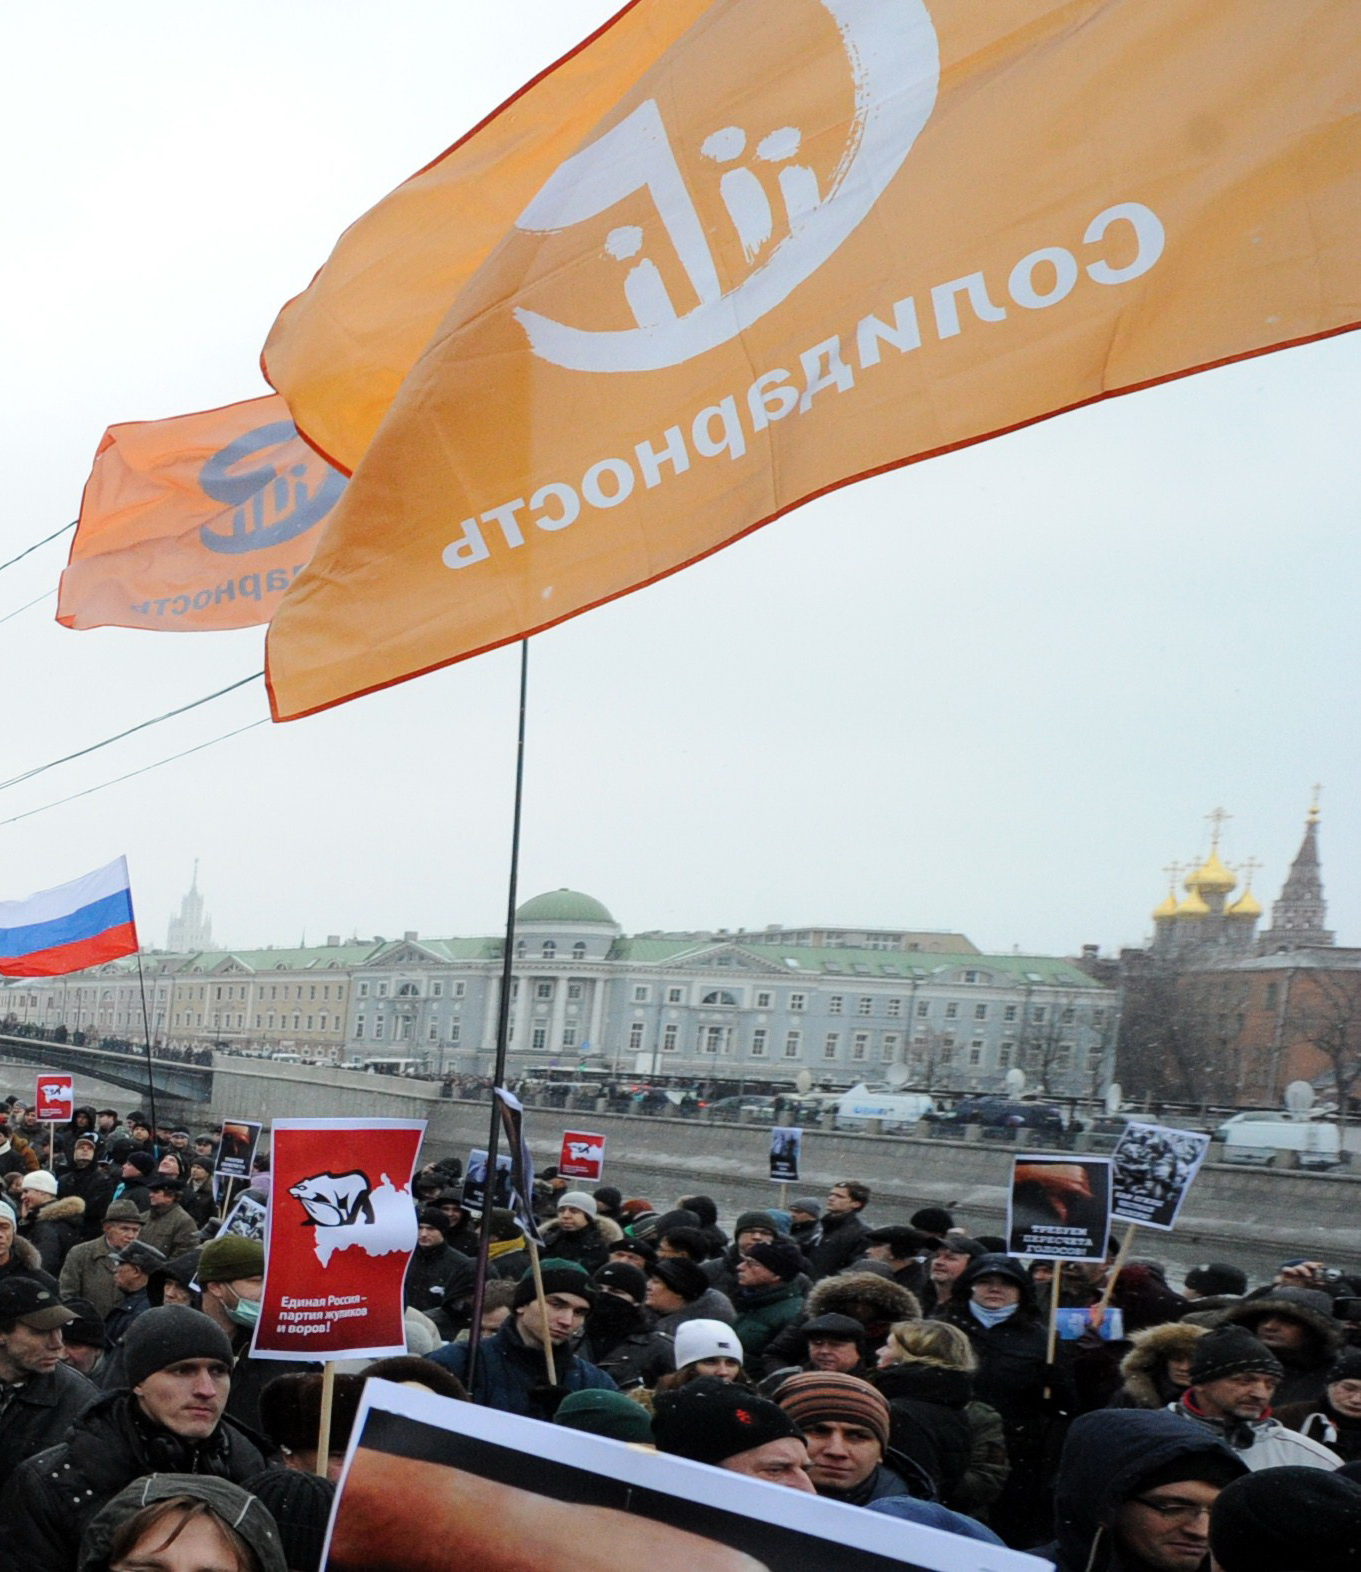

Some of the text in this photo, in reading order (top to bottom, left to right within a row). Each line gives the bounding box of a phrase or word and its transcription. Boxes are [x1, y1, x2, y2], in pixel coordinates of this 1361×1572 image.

[280, 1295, 327, 1310] Единая
[327, 1294, 361, 1306] Россия
[279, 1307, 368, 1323] партия жуликов
[276, 1320, 331, 1336] и воров!
